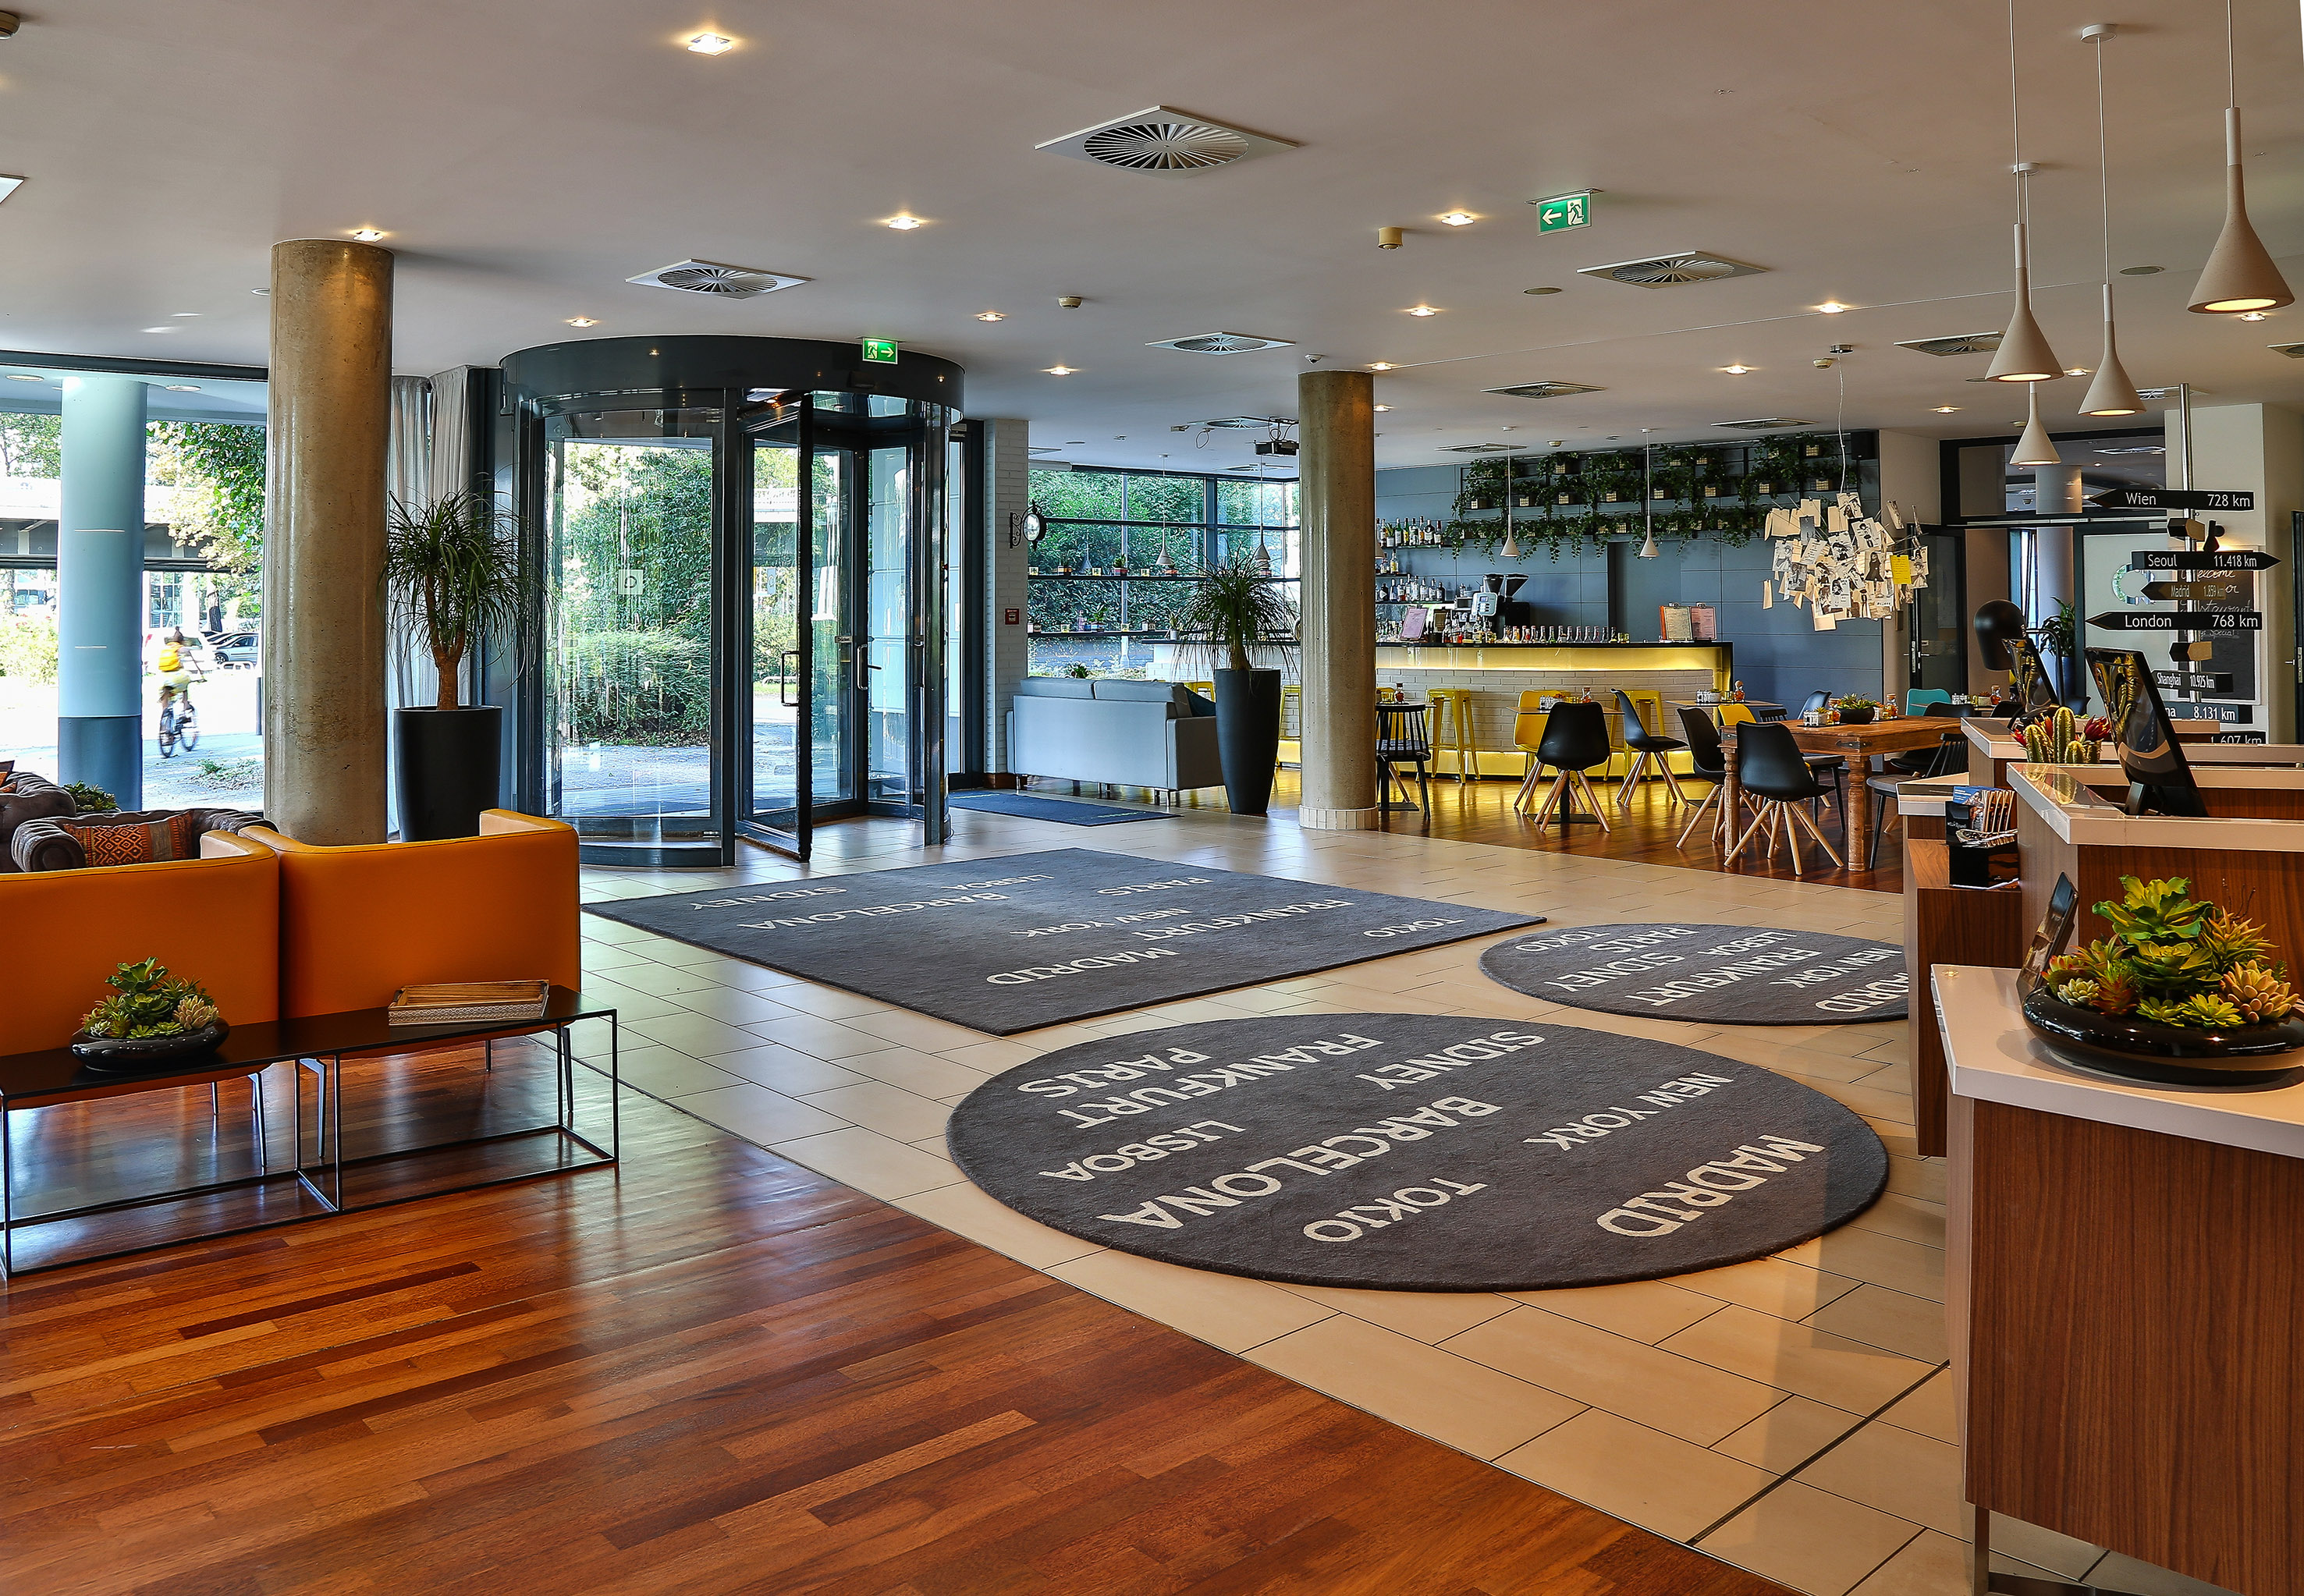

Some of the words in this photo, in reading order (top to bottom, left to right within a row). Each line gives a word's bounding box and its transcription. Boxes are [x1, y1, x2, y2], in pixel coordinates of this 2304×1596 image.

[2125, 492, 2157, 505] Wien
[2207, 494, 2229, 507] 728
[2232, 495, 2251, 507] km
[2148, 553, 2178, 567] Seoul
[2213, 555, 2242, 567] 11.418
[2244, 555, 2257, 567] km
[2171, 584, 2190, 598] Madrid
[2124, 614, 2172, 628] London
[2211, 615, 2235, 628] 768
[2239, 614, 2259, 628] km
[2157, 672, 2182, 689] Shanghai
[2189, 674, 2206, 689] 10.925
[2206, 676, 2215, 690] km
[2193, 705, 2218, 720] 8.131
[2221, 707, 2235, 722] km
[941, 874, 1054, 891] LISBOA
[1096, 877, 1214, 896] PARIS
[690, 886, 847, 910] SIDNEY
[737, 892, 1010, 930] BARCELONA
[1009, 920, 1116, 938] YORK
[1114, 908, 1194, 924] NEW
[1131, 899, 1355, 942] FRANKFURT
[1362, 917, 1466, 938] TOKIO
[1514, 931, 1611, 952] TOKIO
[1588, 927, 1699, 954] PARIS
[1697, 931, 1798, 957] LISBOA
[985, 947, 1180, 984] MADRID
[1835, 947, 1903, 967] NEW
[1543, 952, 1685, 992] SIDNEY
[1624, 946, 1823, 1006] FRANKFURT
[1768, 965, 1861, 989] YORK
[1815, 972, 1909, 1013] ADRID
[1017, 1047, 1214, 1098] PARIS
[1354, 1031, 1546, 1091] SIDNEY
[1056, 1033, 1385, 1130] FRANKFURT
[1633, 1072, 1734, 1108] NEW
[1522, 1106, 1662, 1151] YORK
[1035, 1119, 1248, 1182] LISBOA
[1095, 1095, 1504, 1229] BARCELONA
[1596, 1134, 1827, 1237] MADRID
[1303, 1177, 1489, 1243] TOKIO
